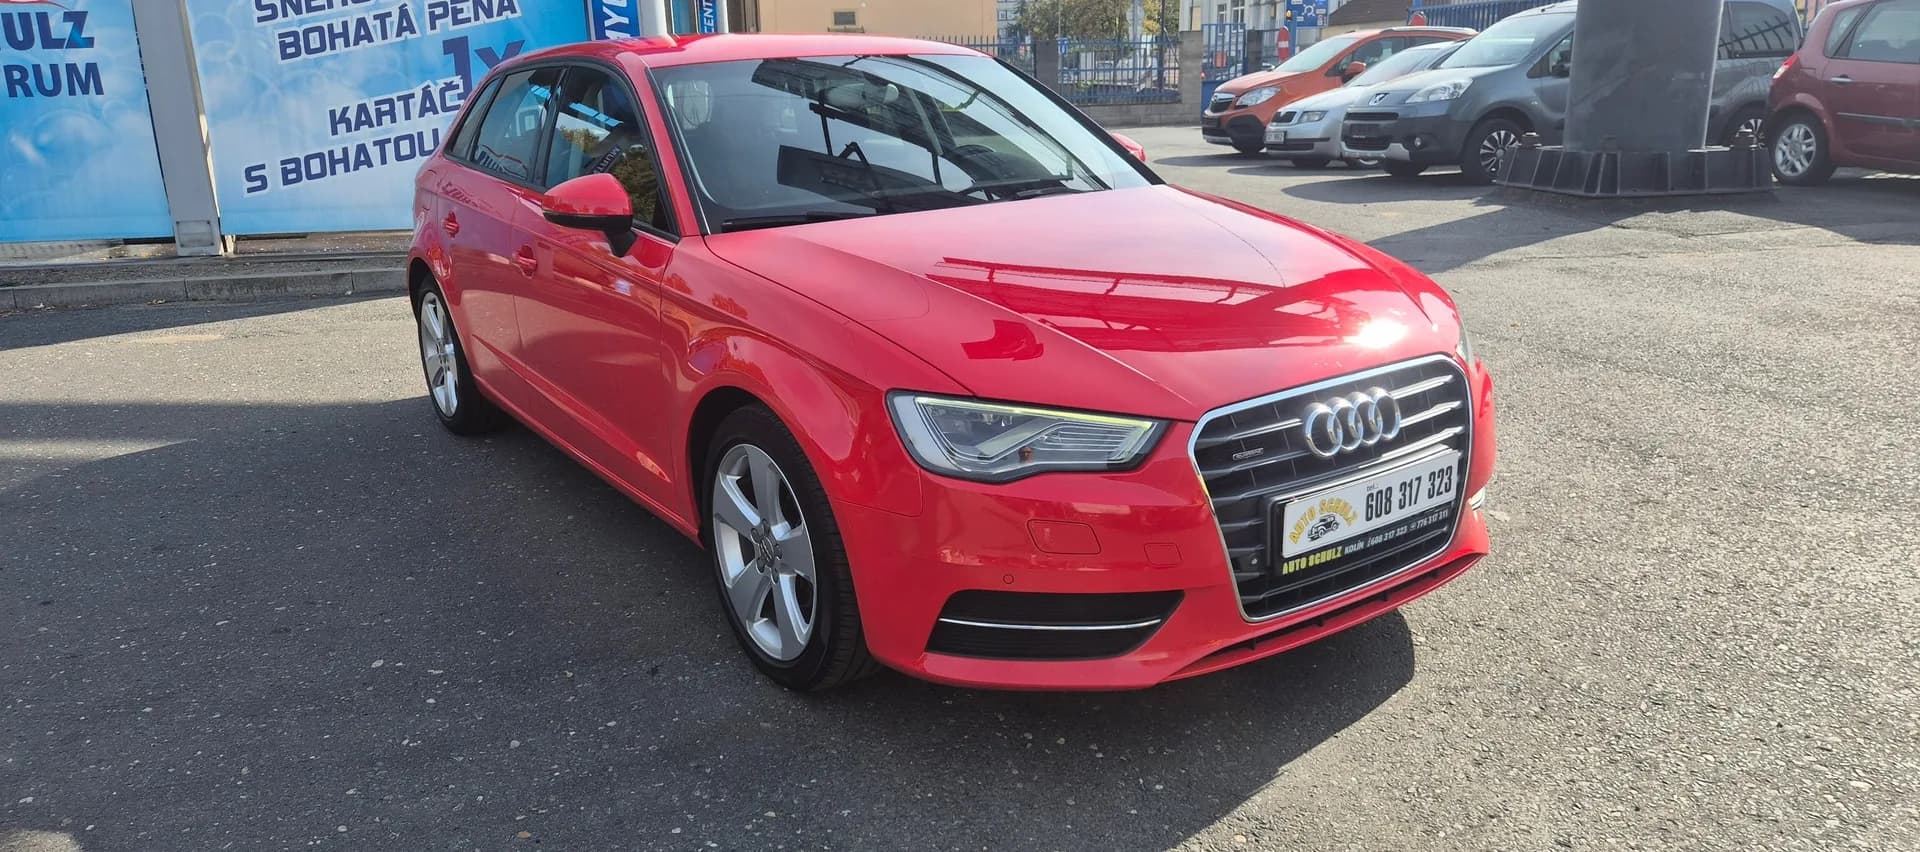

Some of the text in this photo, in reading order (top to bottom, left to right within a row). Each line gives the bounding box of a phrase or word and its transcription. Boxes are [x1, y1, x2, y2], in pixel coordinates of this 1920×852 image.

[1, 10, 95, 51] ULZ
[278, 3, 417, 61] BOHATÁ
[3, 62, 104, 98] RUM
[328, 80, 461, 136] KARTÁČ
[245, 163, 268, 194] S
[280, 127, 440, 186] BOHATOU
[1365, 464, 1453, 522] 608 317 323
[1289, 506, 1317, 544] AUTO
[1282, 558, 1307, 575] AUTO
[1308, 546, 1343, 567] SCHULZ
